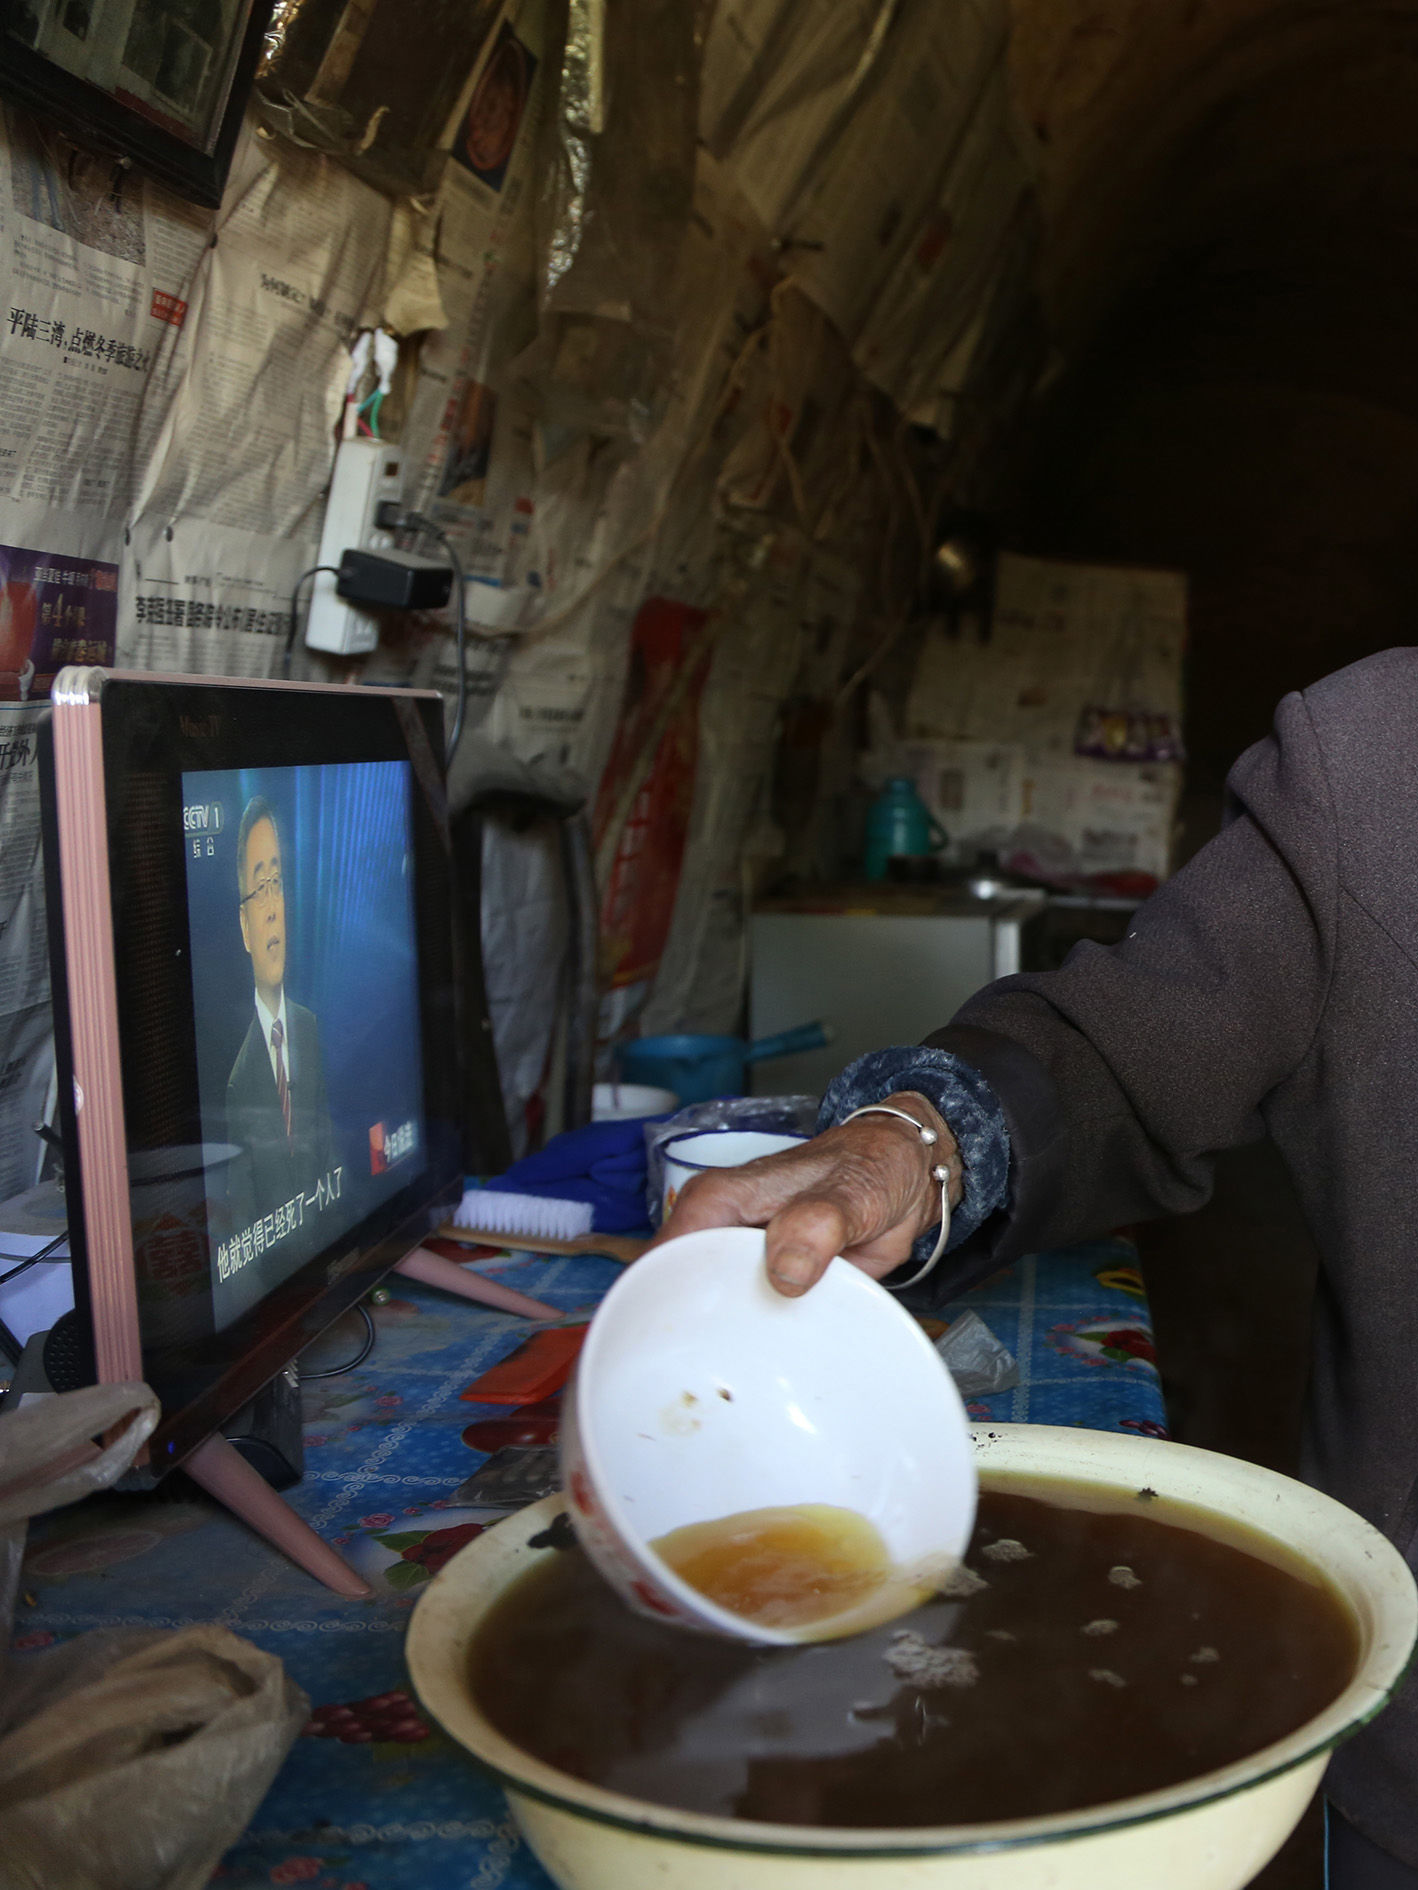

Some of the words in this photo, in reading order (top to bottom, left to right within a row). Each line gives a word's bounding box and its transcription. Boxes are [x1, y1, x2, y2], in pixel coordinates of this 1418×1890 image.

[183, 804, 209, 831] CCTV
[217, 1166, 342, 1283] 他就觉得已经死了一个人了
